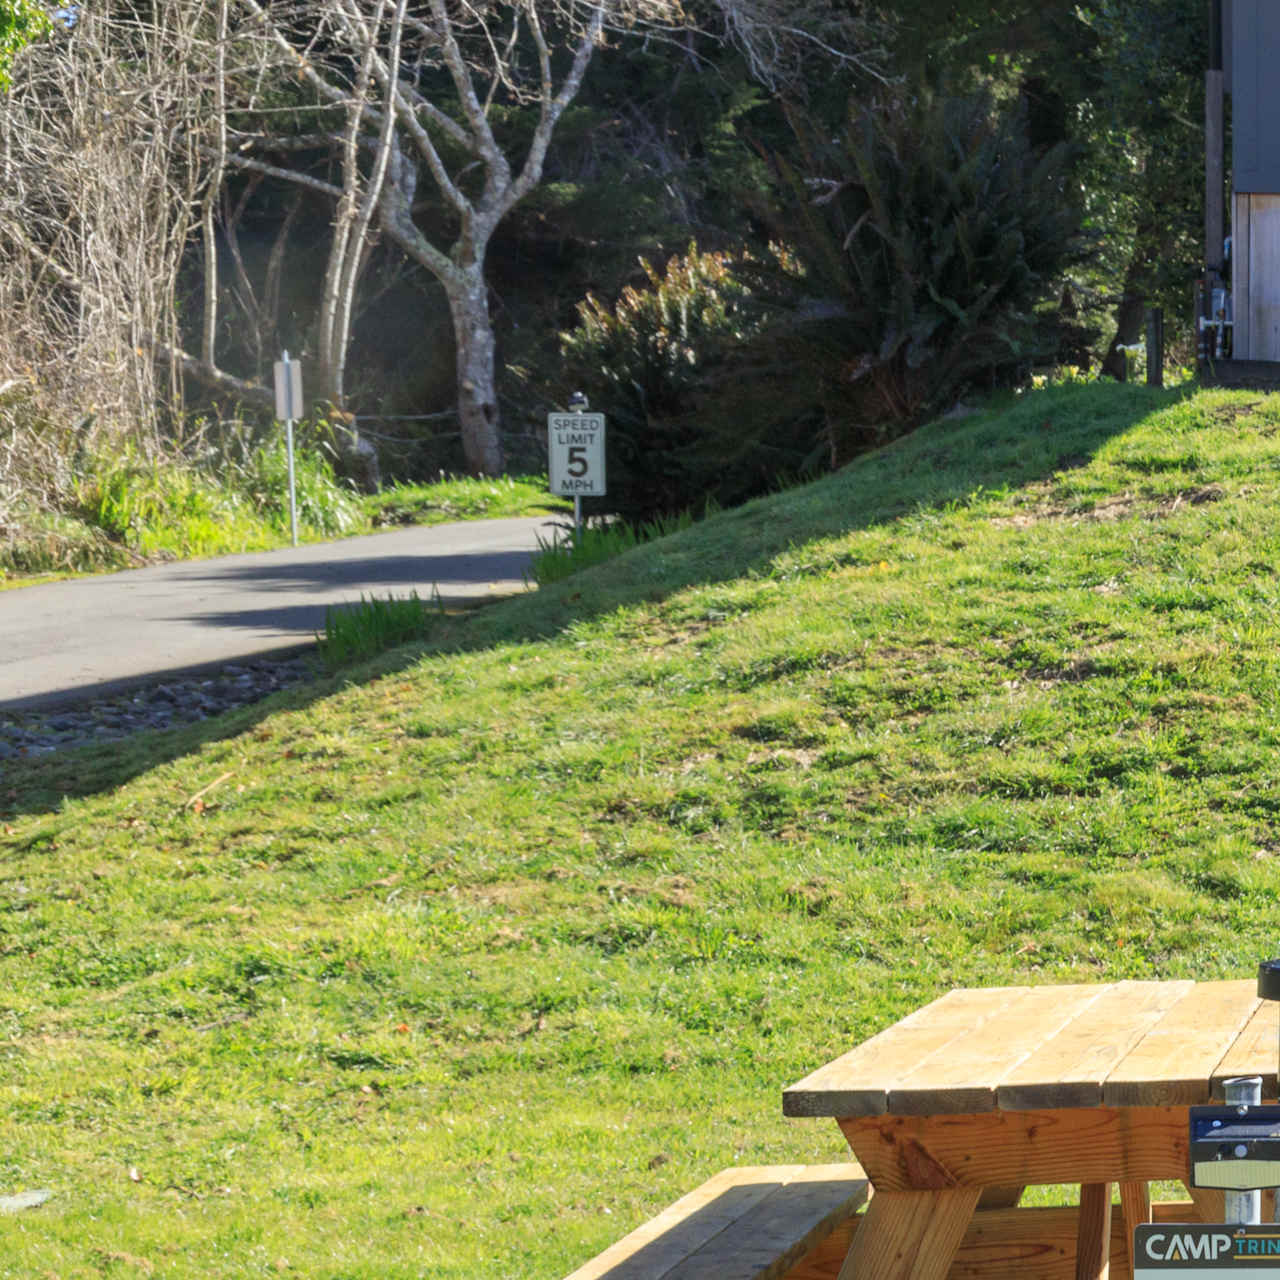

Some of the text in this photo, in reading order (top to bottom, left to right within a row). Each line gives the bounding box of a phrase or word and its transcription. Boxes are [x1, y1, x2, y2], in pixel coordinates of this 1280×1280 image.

[553, 419, 600, 430] SPEED
[558, 433, 596, 444] LIMIT
[567, 447, 588, 477] 5
[561, 480, 593, 491] MPH
[1145, 1234, 1232, 1260] CAMP
